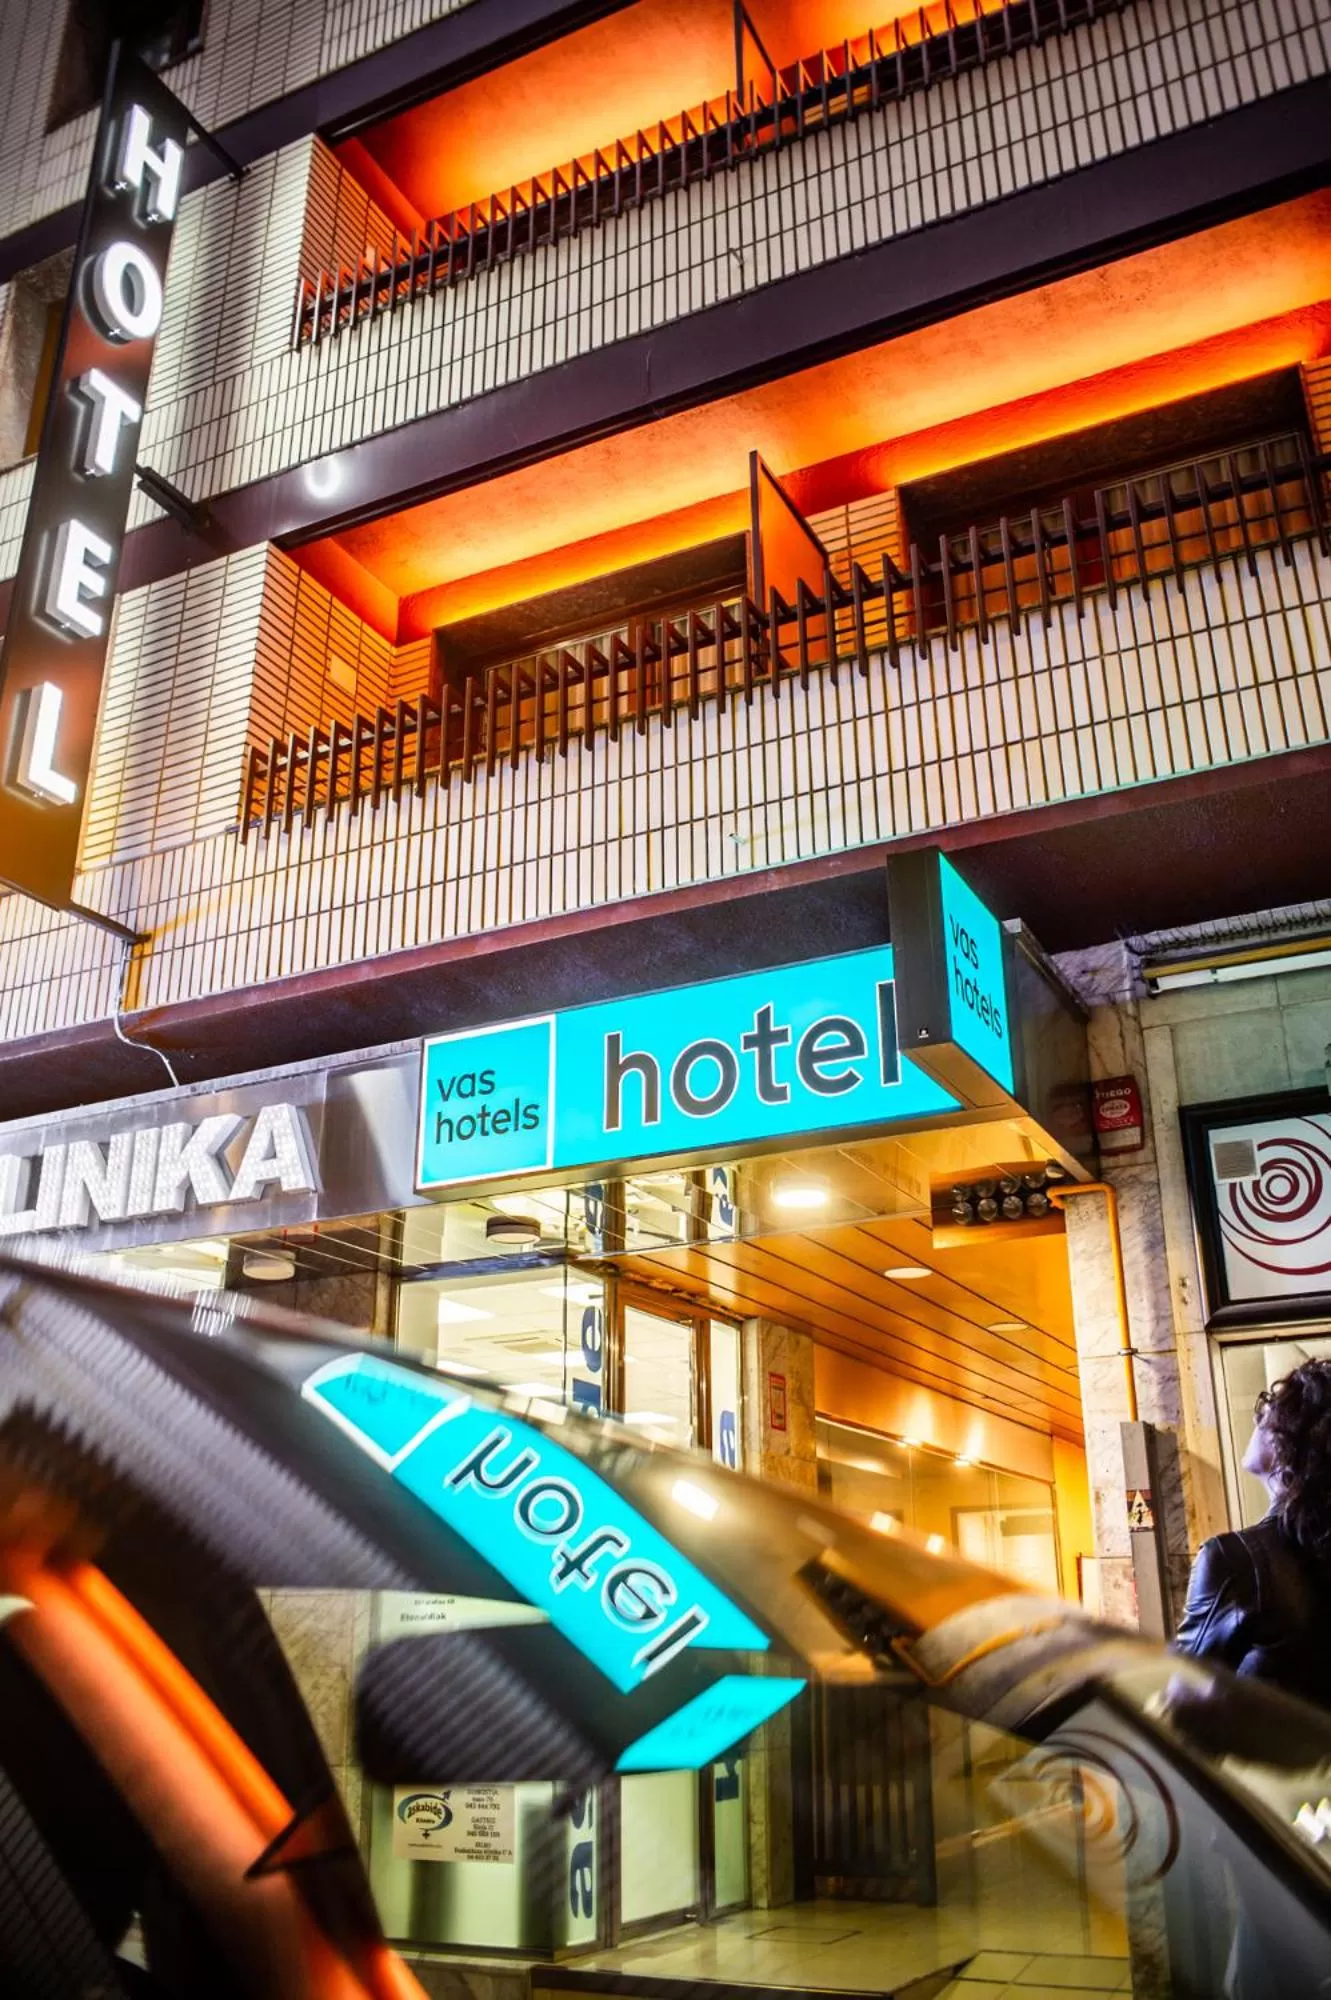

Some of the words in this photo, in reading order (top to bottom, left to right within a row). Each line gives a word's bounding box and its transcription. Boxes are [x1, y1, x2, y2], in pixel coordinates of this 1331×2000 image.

[16, 102, 184, 805] HOTEL
[949, 913, 980, 971] vas
[953, 955, 1004, 1040] hotels
[435, 1066, 496, 1103] vas
[603, 979, 902, 1134] hotel
[435, 1097, 540, 1145] hotels
